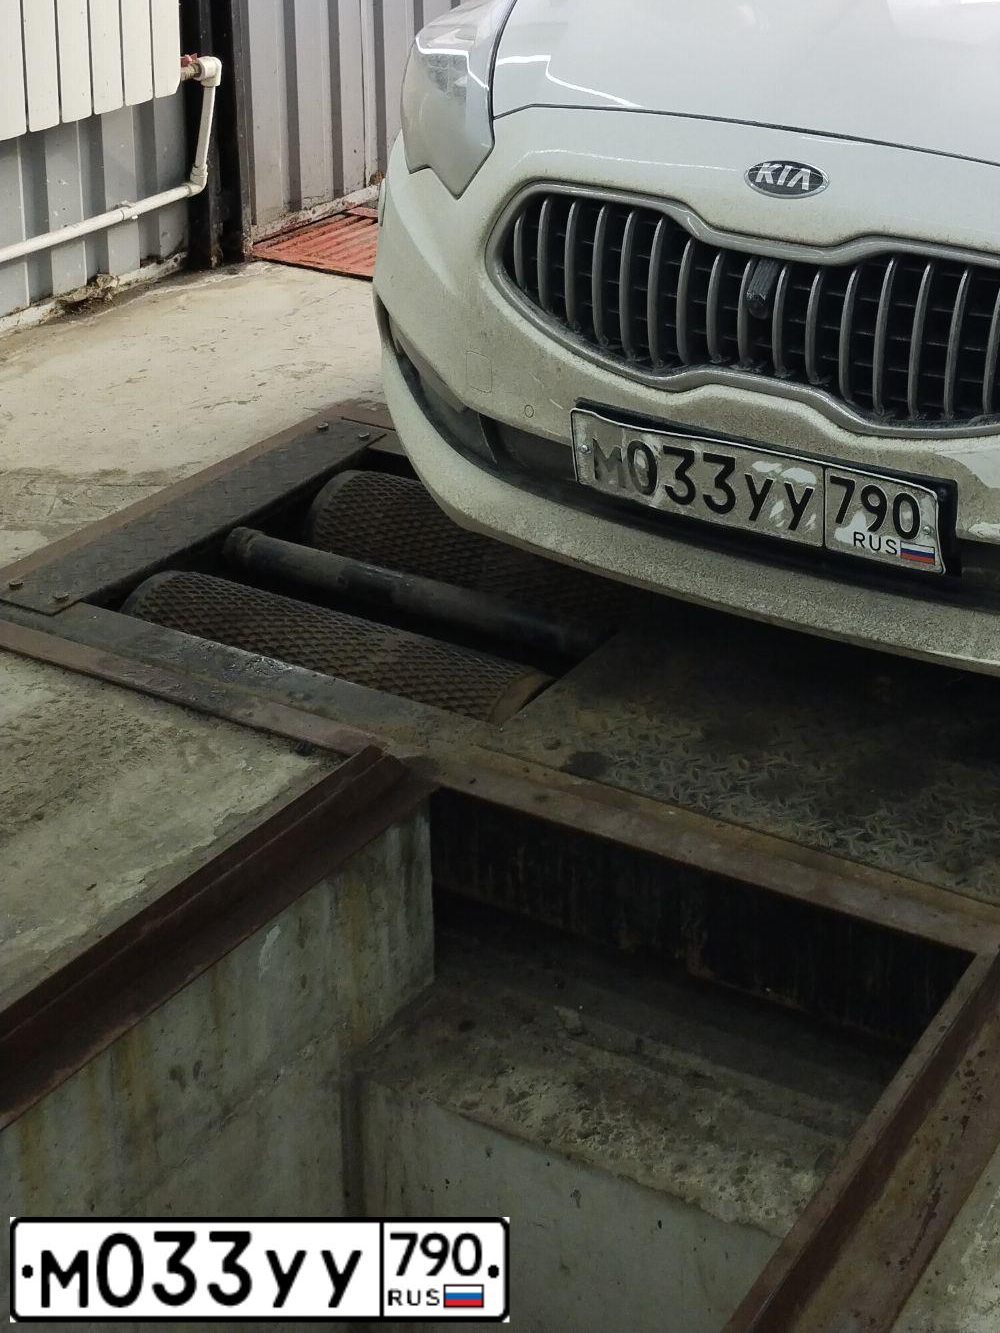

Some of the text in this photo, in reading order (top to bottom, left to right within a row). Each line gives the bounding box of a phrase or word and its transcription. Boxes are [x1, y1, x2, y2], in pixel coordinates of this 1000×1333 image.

[755, 162, 813, 192] KIA
[829, 475, 922, 540] 790
[852, 530, 898, 557] RUS
